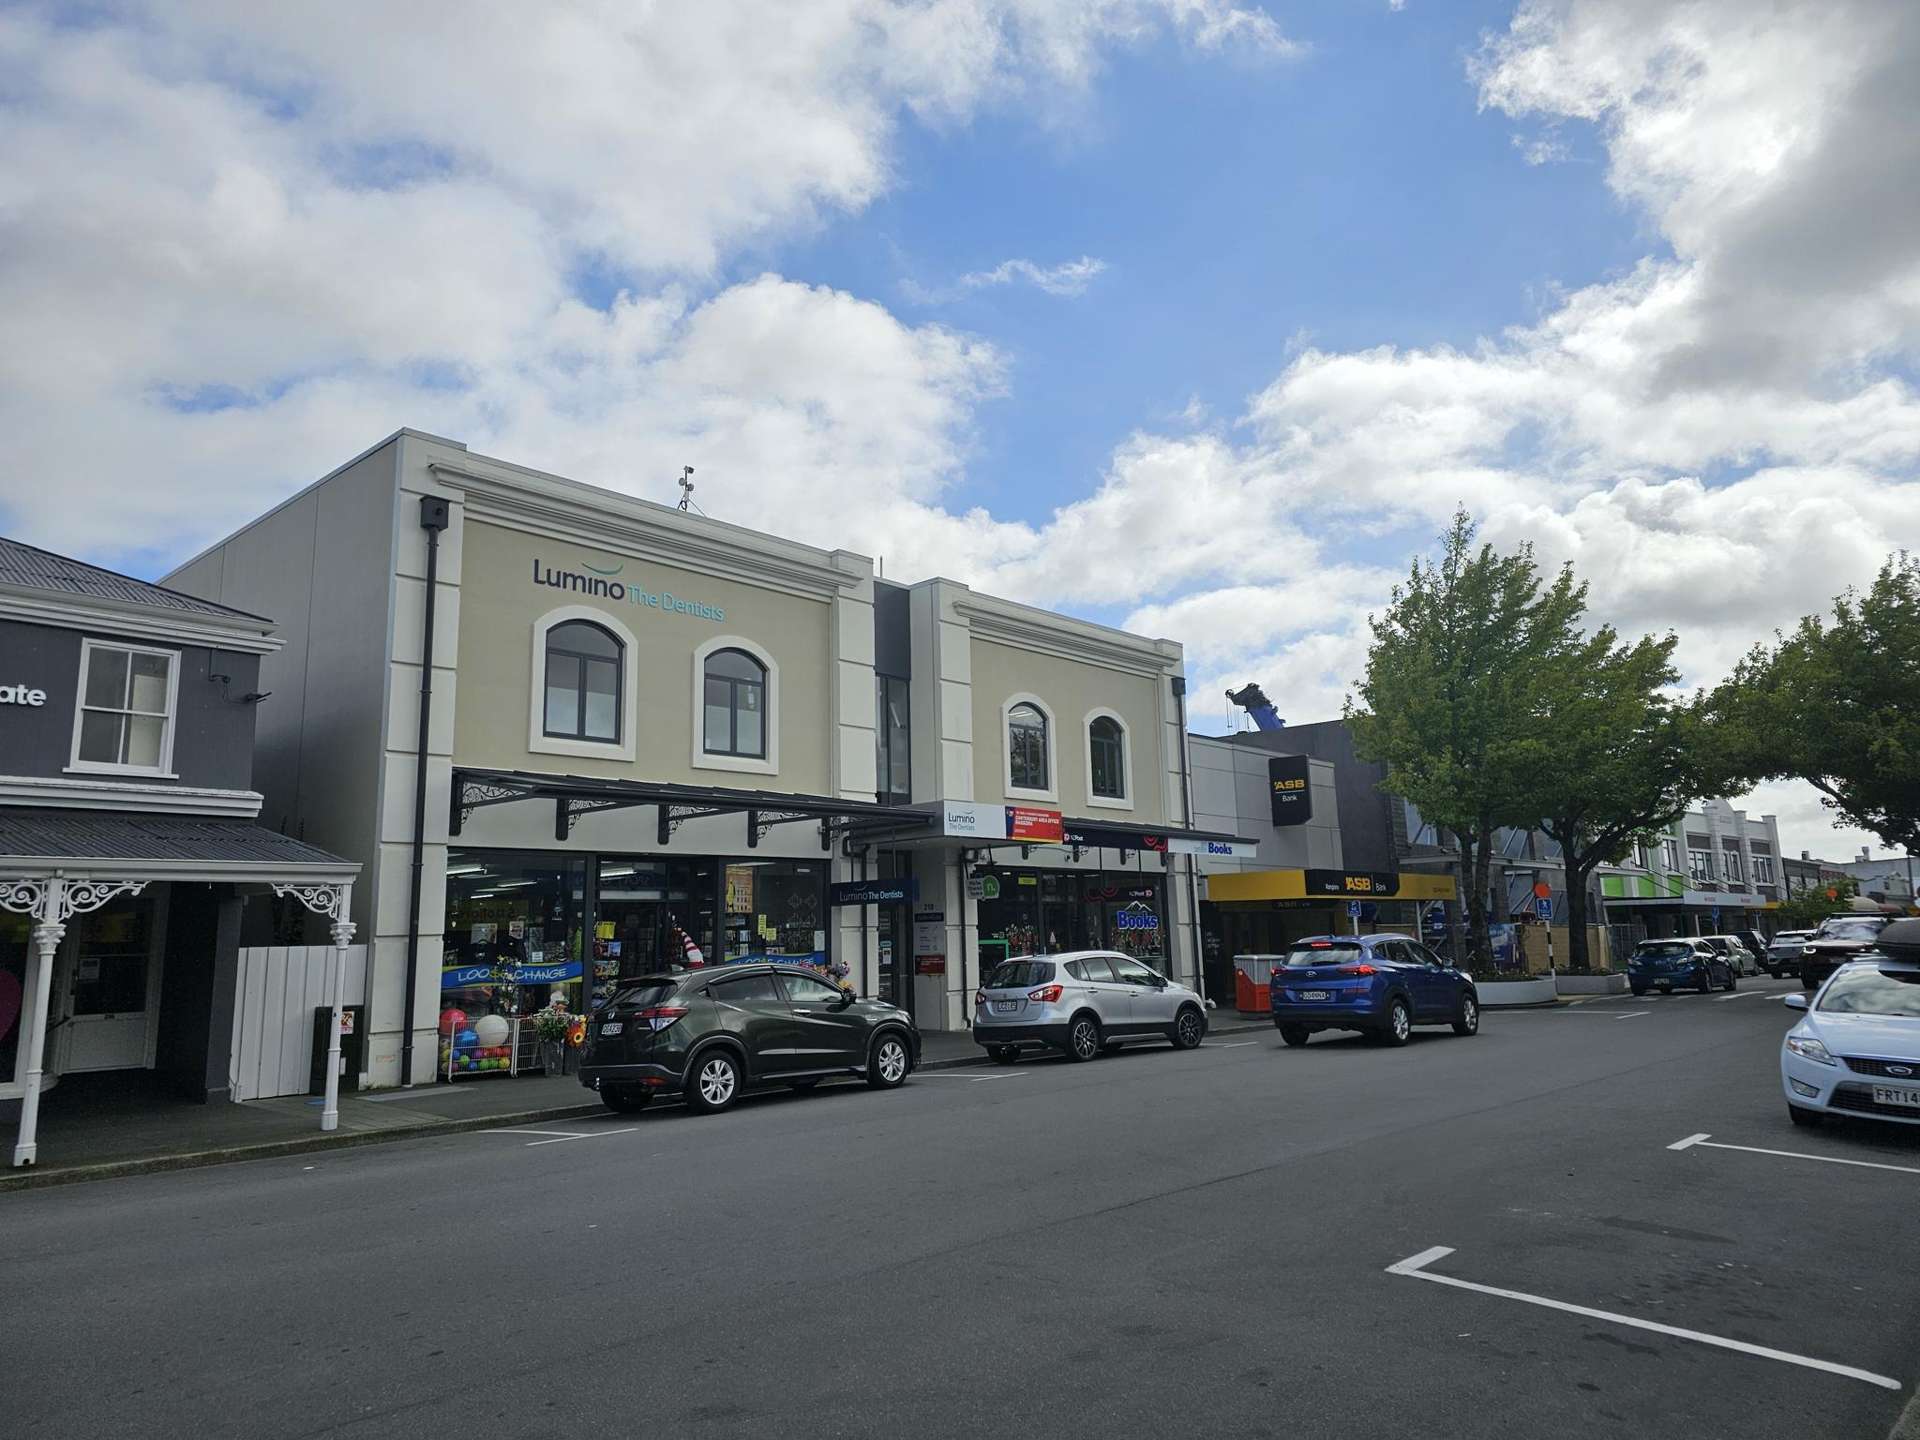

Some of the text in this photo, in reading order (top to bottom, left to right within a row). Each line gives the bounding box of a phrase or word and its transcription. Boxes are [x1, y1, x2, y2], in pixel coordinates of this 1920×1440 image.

[534, 559, 726, 623] Lumino The Dentists
[1274, 779, 1305, 790] ASB
[948, 812, 975, 824] Lumino
[1207, 841, 1233, 855] Books
[1346, 877, 1371, 891] ASB
[839, 889, 904, 902] Lumino The Dentists
[1117, 910, 1159, 930] Books
[512, 967, 568, 981] CHANGE
[1876, 1088, 1920, 1104] FRT14
